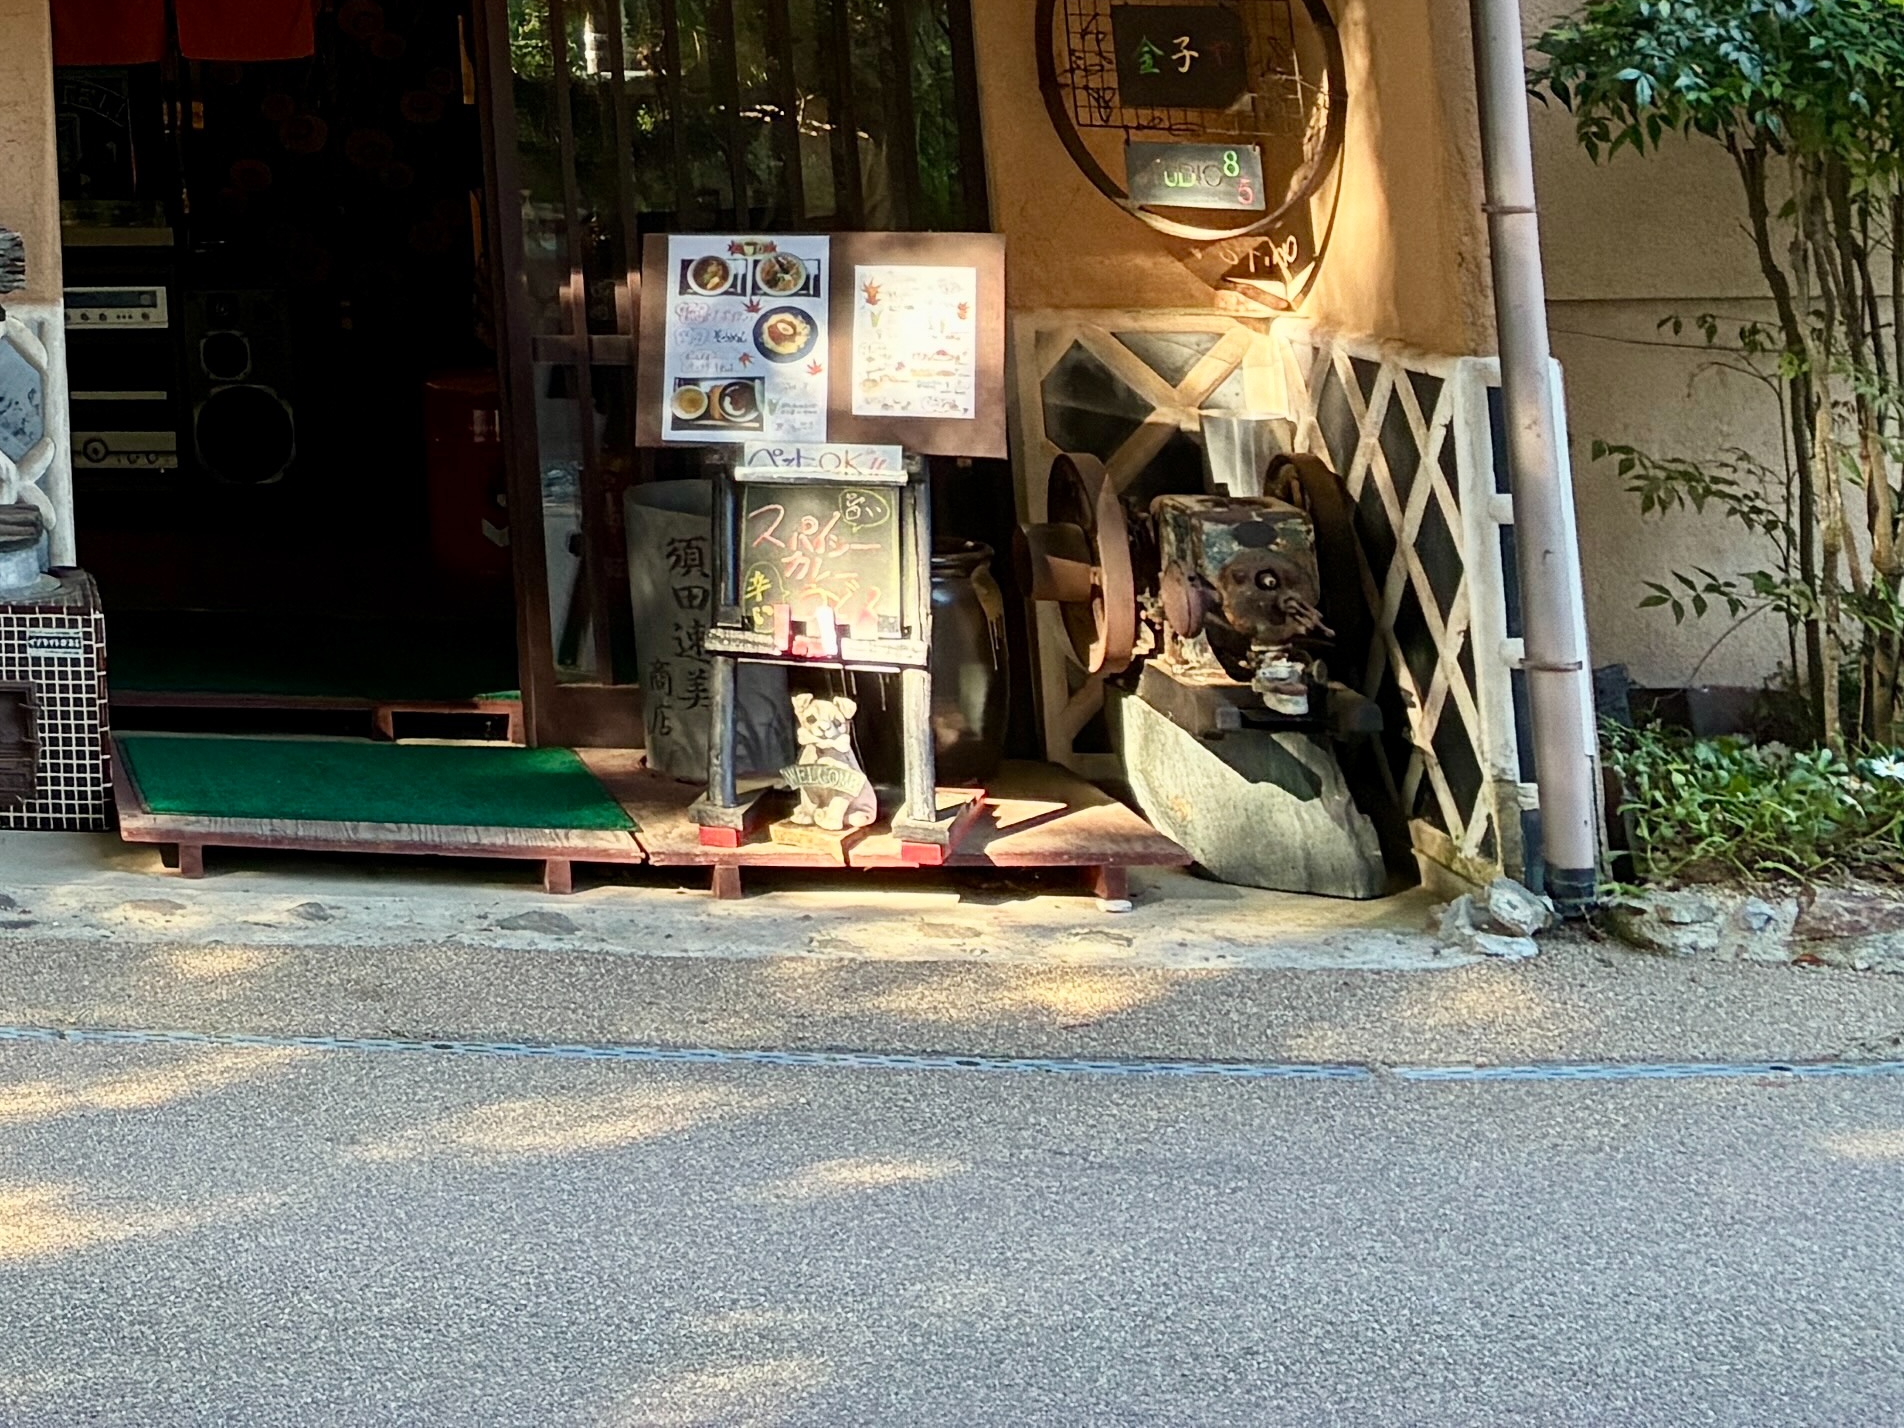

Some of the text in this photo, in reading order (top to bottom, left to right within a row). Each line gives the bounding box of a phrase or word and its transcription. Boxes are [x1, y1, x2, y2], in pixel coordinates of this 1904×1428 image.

[748, 503, 882, 558] スパイシー
[781, 550, 859, 583] カレー
[780, 764, 865, 797] WELCOME
